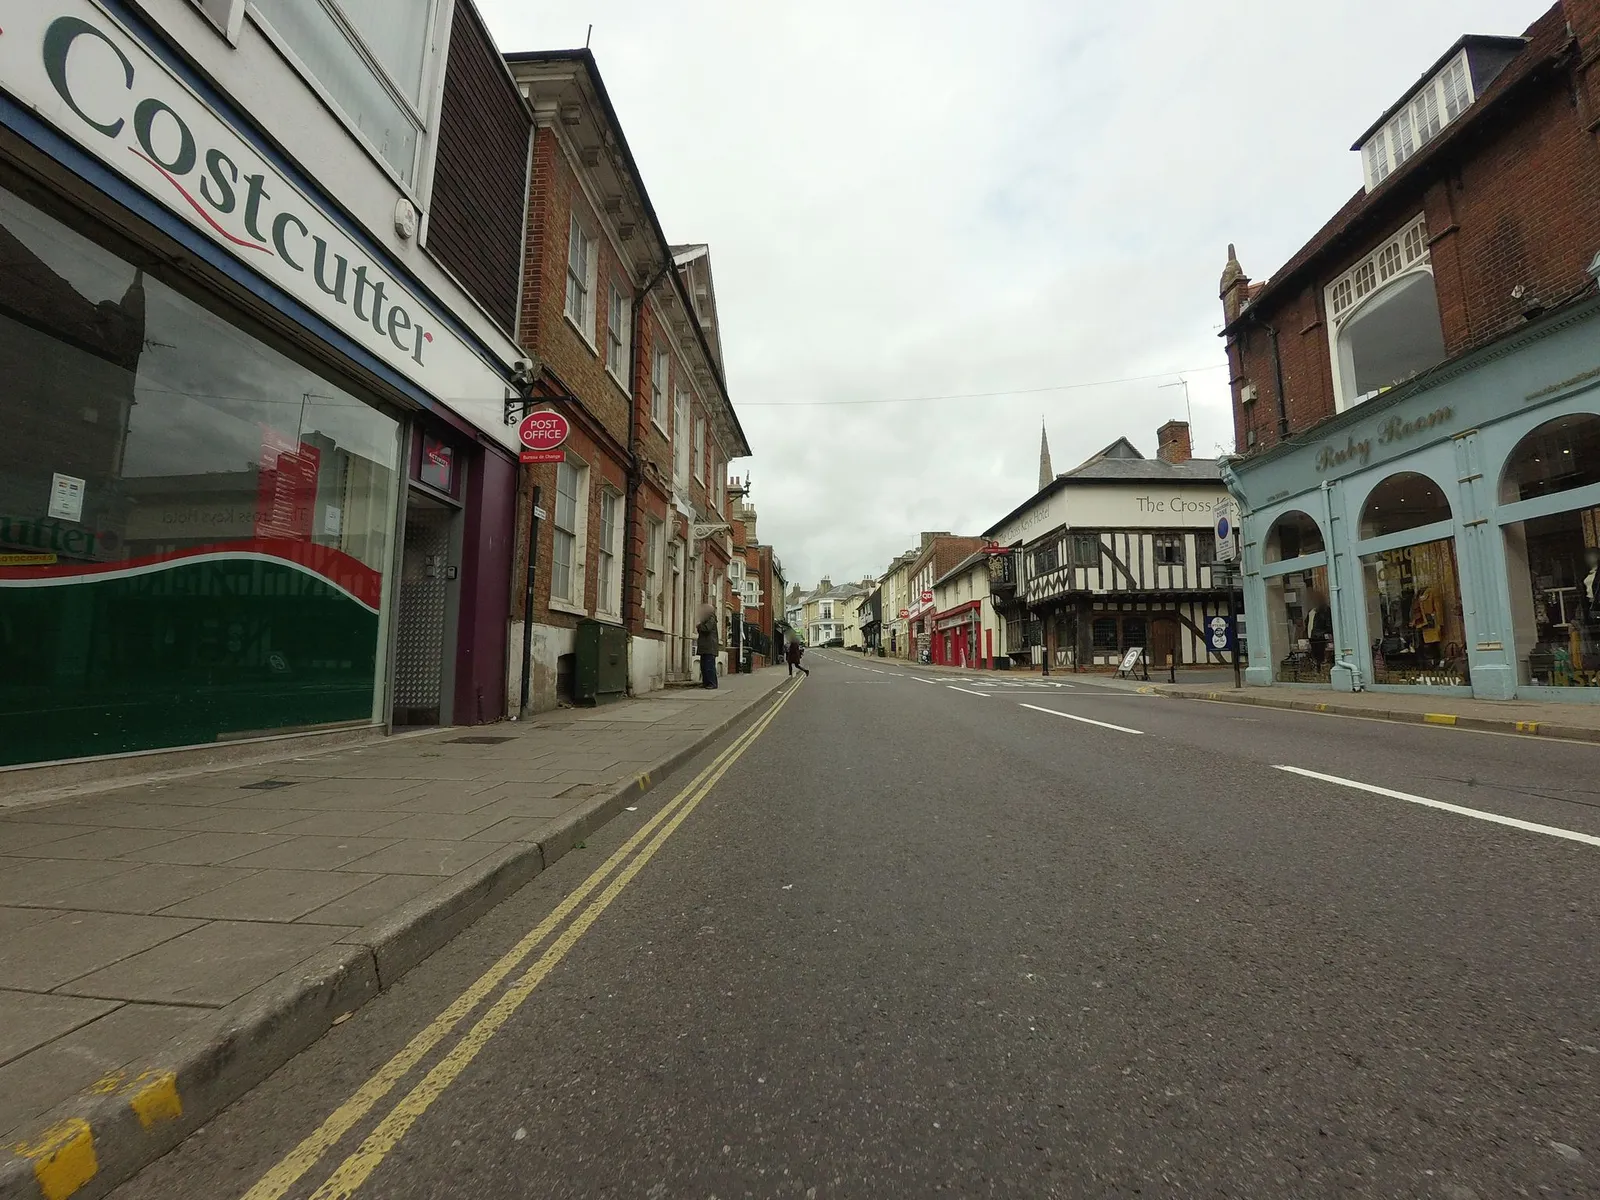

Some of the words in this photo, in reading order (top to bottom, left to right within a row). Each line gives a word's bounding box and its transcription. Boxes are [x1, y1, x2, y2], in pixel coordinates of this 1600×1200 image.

[42, 15, 434, 368] Costcutter
[523, 430, 562, 440] OFFICE
[530, 420, 559, 430] POST
[1315, 436, 1373, 472] Ruby
[1377, 405, 1456, 445] Room
[1136, 496, 1165, 512] The
[1170, 497, 1212, 512] Cross
[998, 532, 1007, 543] The
[1007, 526, 1021, 540] Cross
[1021, 519, 1033, 533] Keys
[1033, 503, 1050, 524] Hotel
